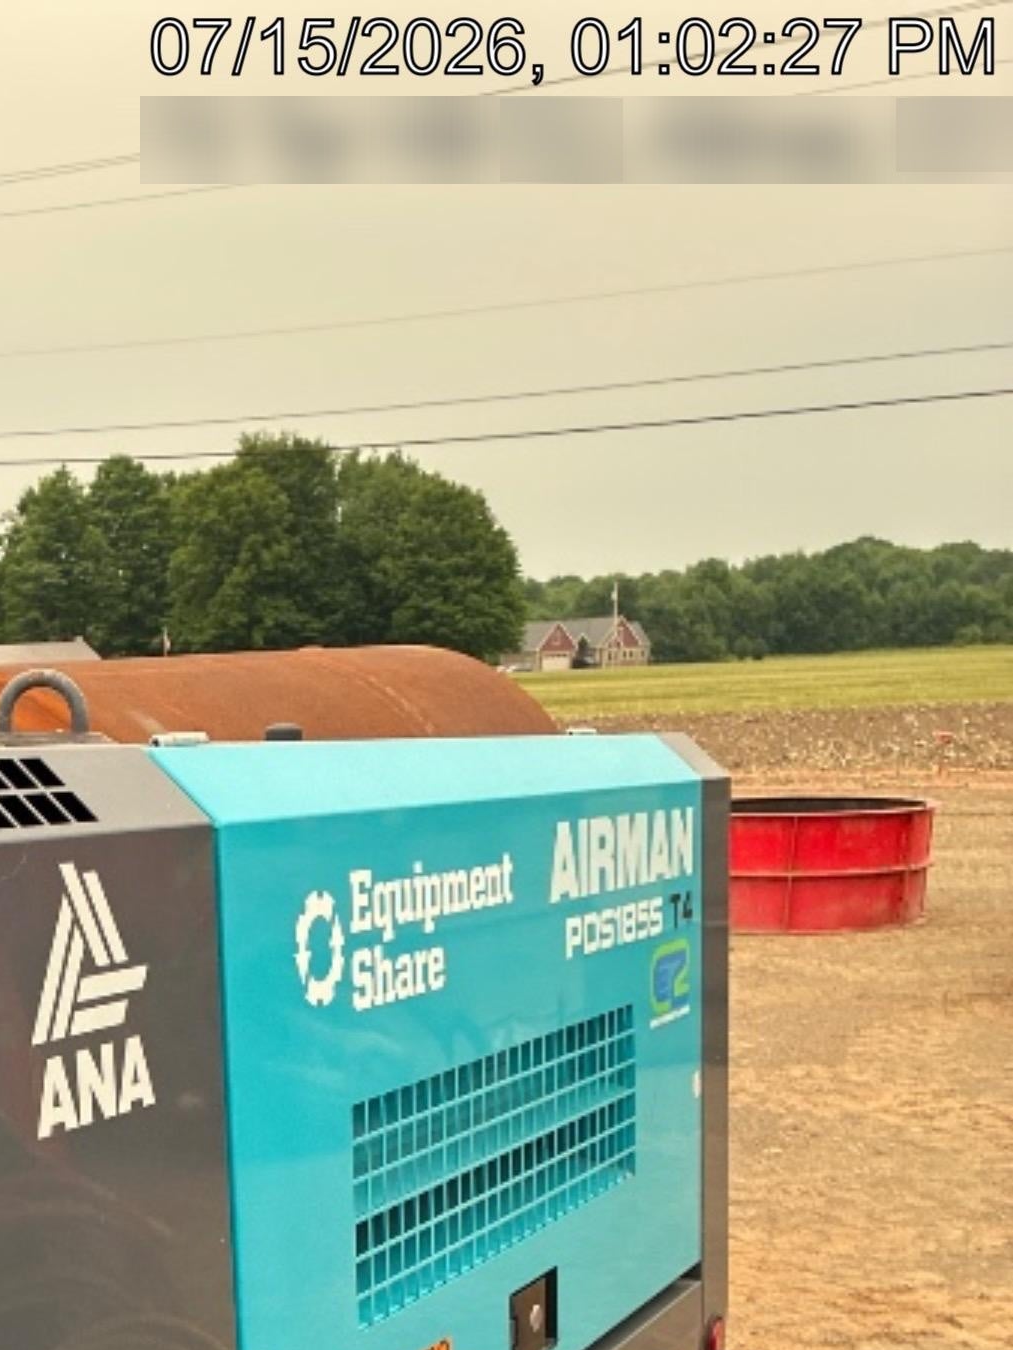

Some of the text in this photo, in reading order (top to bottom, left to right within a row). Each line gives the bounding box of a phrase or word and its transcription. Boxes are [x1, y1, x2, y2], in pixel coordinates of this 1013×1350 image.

[349, 852, 514, 943] Equipment
[549, 806, 694, 904] AIRMAN
[351, 944, 446, 1012] Share
[37, 1034, 157, 1141] ANA
